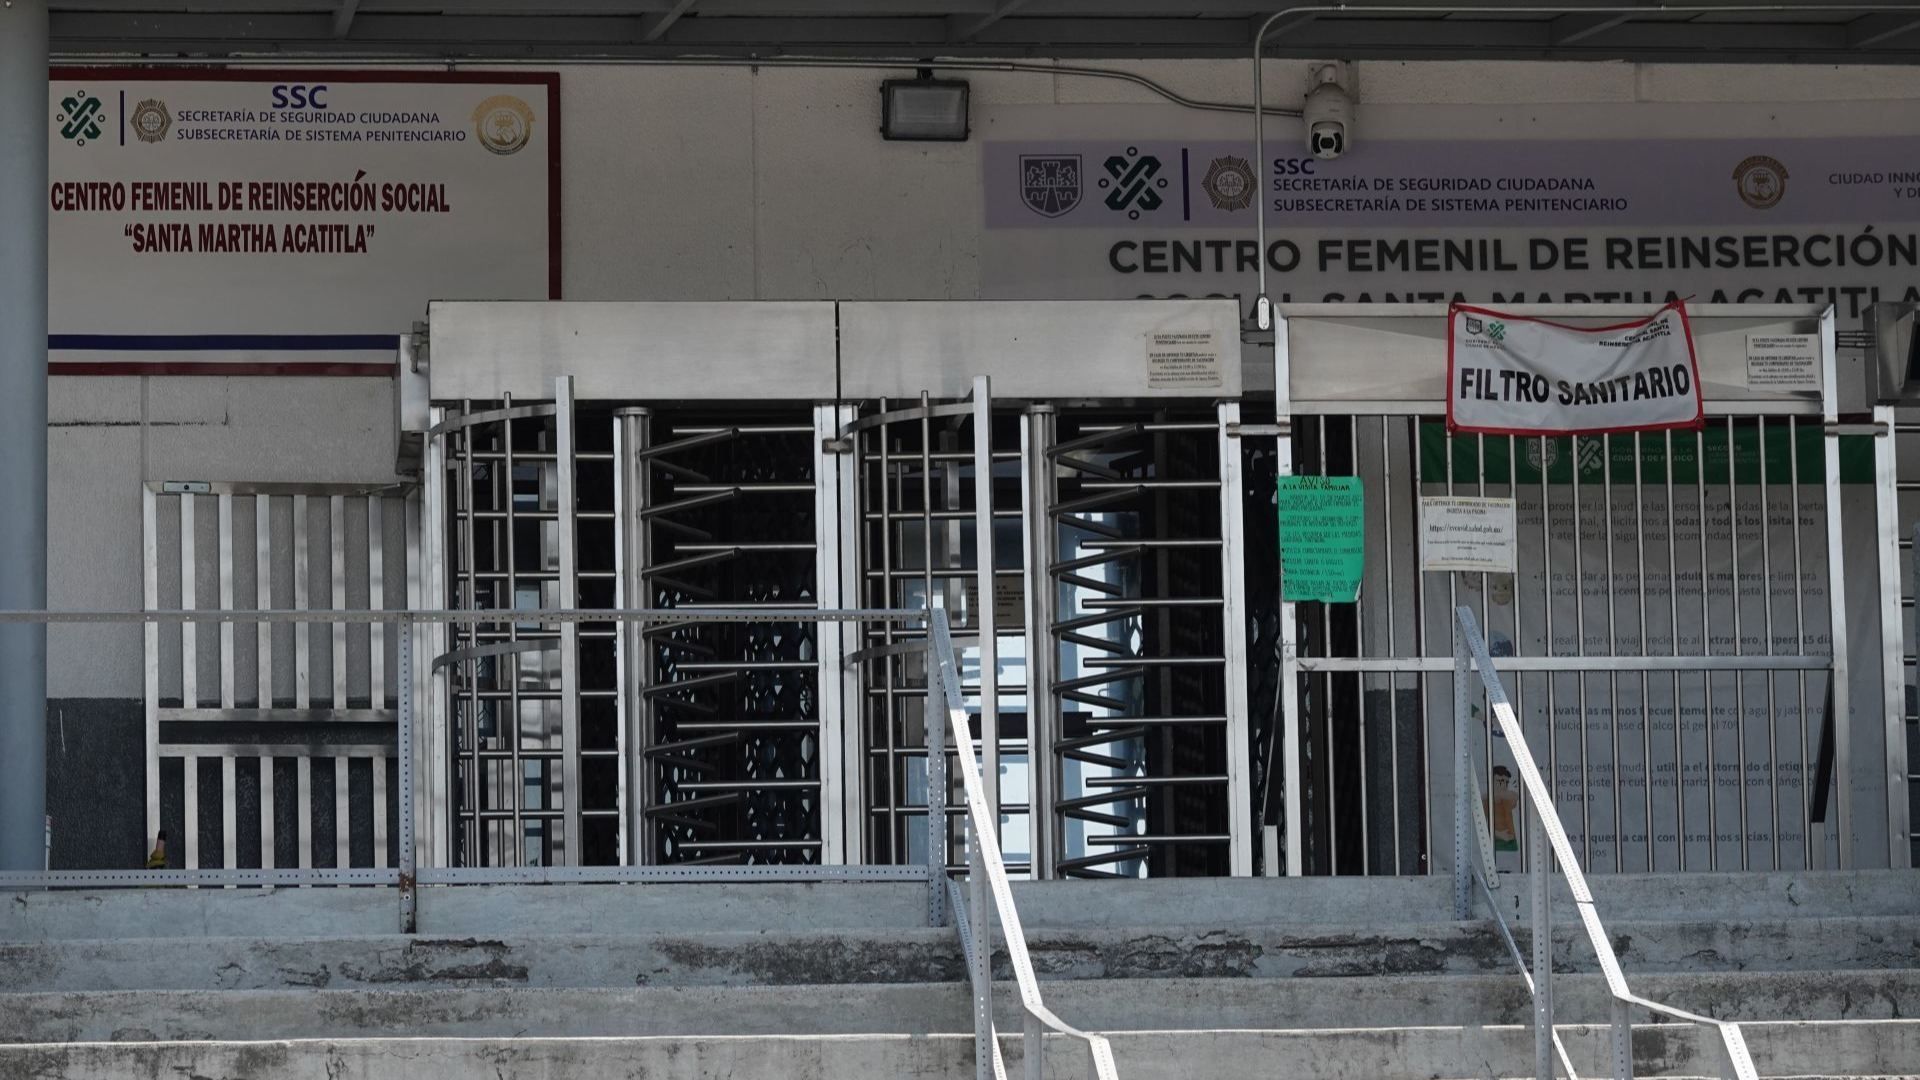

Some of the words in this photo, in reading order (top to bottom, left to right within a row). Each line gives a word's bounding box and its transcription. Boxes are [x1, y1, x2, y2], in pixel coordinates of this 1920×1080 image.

[271, 85, 328, 109] SSC
[178, 108, 253, 124] SECRETARÍA
[256, 110, 276, 123] DE
[280, 111, 357, 124] SEGURIDAD
[359, 112, 440, 124] CIUDADANA
[177, 127, 281, 142] SUBSECRETARÍA
[285, 129, 302, 141] DE
[306, 130, 362, 142] SISTEMA
[367, 130, 466, 142] PENITENCIARIO
[1273, 158, 1315, 175] SSC
[1273, 174, 1369, 191] SECRETARÍA
[1372, 179, 1395, 191] DE
[1399, 178, 1491, 191] SEGURIDAD
[1497, 178, 1595, 191] CIUDADANA
[1829, 173, 1884, 185] CIUDAD
[51, 181, 125, 212] CENTRO
[132, 181, 213, 211] FEMENIL
[219, 182, 243, 211] DE
[249, 170, 377, 212] REINSERCIÓN
[381, 182, 450, 212] SOCIAL
[1894, 187, 1902, 198] Y
[1273, 195, 1401, 212] SUBSECRETARÍA
[1405, 199, 1428, 211] DE
[1431, 198, 1500, 211] SISTEMA
[1505, 197, 1628, 211] PENITENCIARIO
[199, 224, 277, 253] MARTHA
[1109, 240, 1300, 273] CENTRO
[1318, 238, 1518, 272] FEMENIL
[1529, 238, 1589, 271] DE
[1606, 225, 1918, 270] REINSERCIÓN
[1460, 368, 1550, 403] FILTRO
[1557, 363, 1690, 406] SANITARIO
[1549, 501, 1591, 514] proteer
[1606, 501, 1633, 511] alud
[1552, 514, 1599, 528] persnal,
[1670, 515, 1700, 525] odas
[1712, 515, 1742, 525] tods
[1744, 515, 1760, 525] los
[1763, 514, 1815, 526] isitates
[1559, 530, 1597, 541] ateder
[1566, 571, 1597, 581] cudar
[1675, 571, 1714, 581] adults
[1717, 573, 1763, 583] maores
[1618, 586, 1656, 595] centos
[1797, 586, 1823, 595] viso
[1554, 634, 1603, 645] realiaste
[1622, 634, 1645, 648] viaj
[1703, 634, 1762, 648] xtranero,
[1817, 634, 1834, 645] día
[1601, 706, 1637, 715] mnos
[1748, 707, 1772, 718] agu
[1783, 705, 1813, 718] jabn
[1611, 721, 1634, 730] ase
[1652, 720, 1690, 730] alcool
[1558, 763, 1585, 772] tose
[1656, 762, 1690, 773] utila
[1569, 777, 1611, 787] cosiste
[1566, 792, 1595, 802] brao
[1580, 833, 1617, 845] tques
[1632, 834, 1652, 842] car
[1657, 834, 1676, 842] con
[1679, 833, 1693, 842] as
[1735, 831, 1772, 845] scias,
[1774, 832, 1802, 842] obre
[1588, 848, 1607, 859] jos
